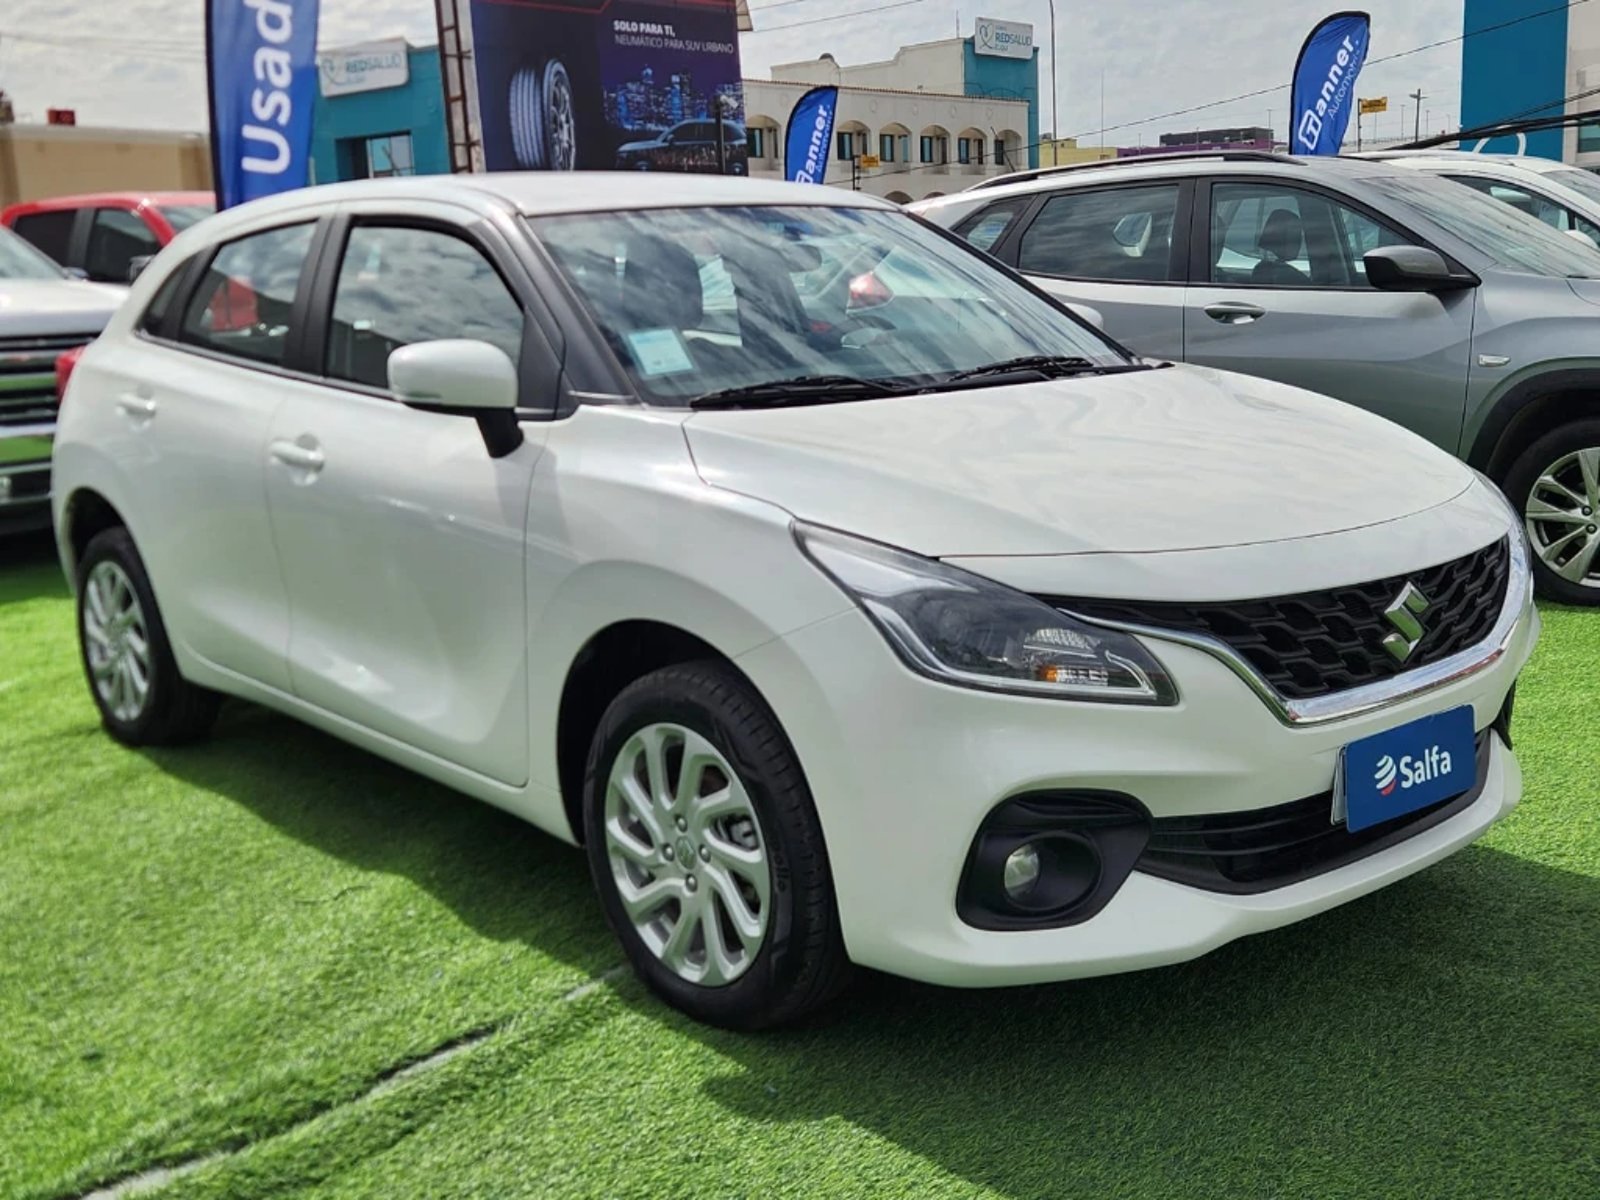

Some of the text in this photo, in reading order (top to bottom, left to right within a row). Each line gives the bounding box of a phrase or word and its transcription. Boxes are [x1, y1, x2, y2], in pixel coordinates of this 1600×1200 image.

[613, 20, 675, 37] SOLO PARA TI,
[615, 33, 734, 54] NEUMÁTICO PARA SUV URBANO
[995, 32, 1032, 46] REDSALUD
[1400, 745, 1452, 788] Salfa
